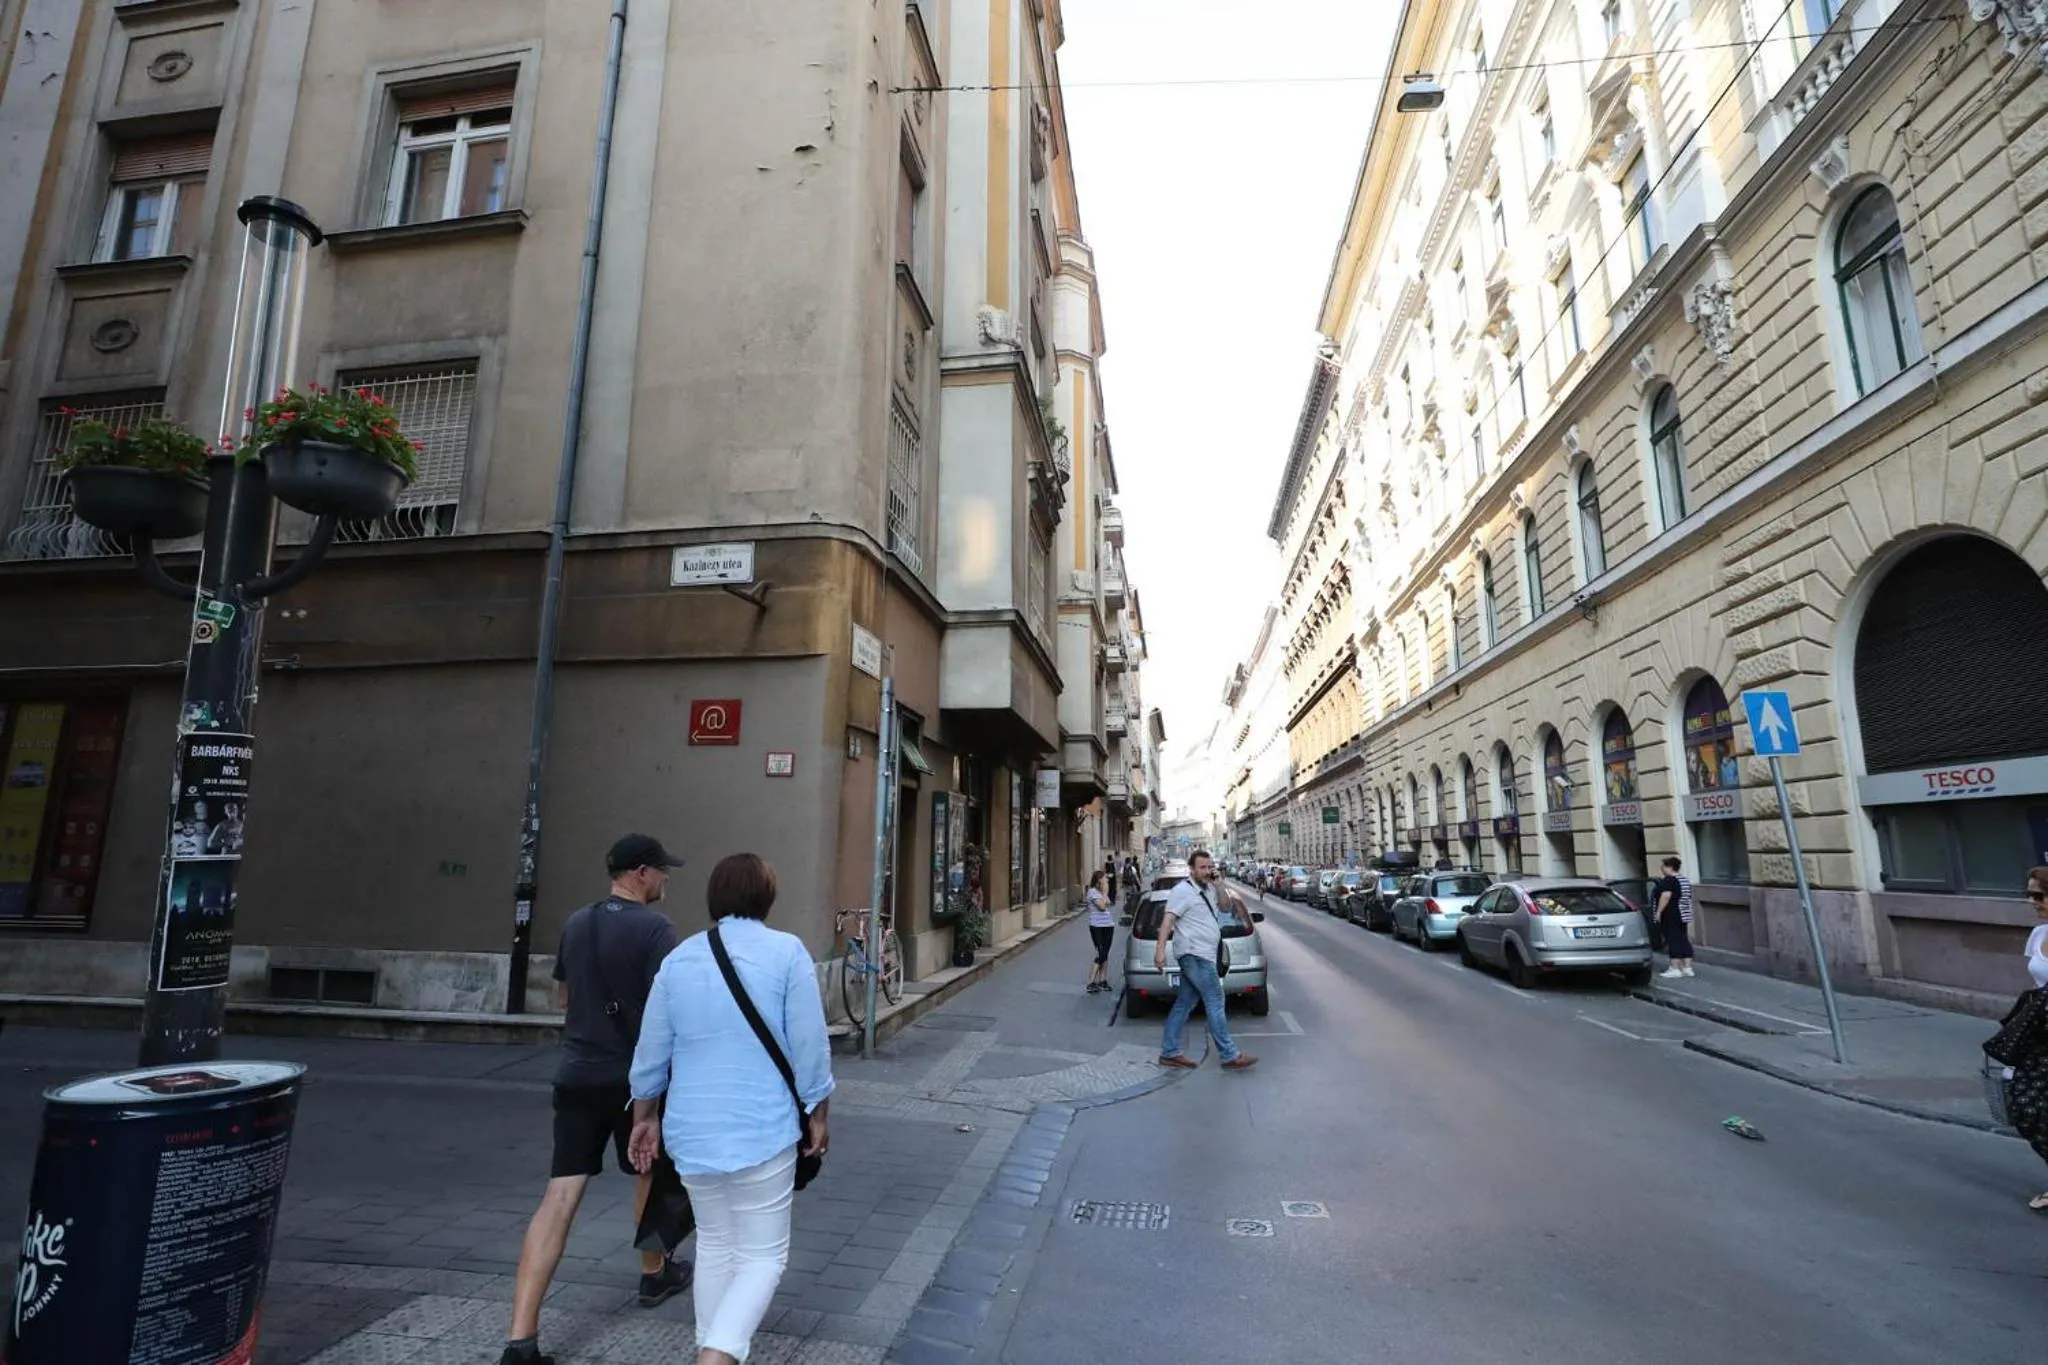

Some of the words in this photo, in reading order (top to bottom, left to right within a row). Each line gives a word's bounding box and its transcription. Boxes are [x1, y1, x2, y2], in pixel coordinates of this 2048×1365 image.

[683, 560, 722, 573] Kazinczy
[722, 558, 743, 569] utca
[221, 765, 240, 776] NKS
[1922, 767, 1994, 788] TESCO
[1694, 795, 1733, 810] TESCO
[1611, 804, 1637, 817] TESCO
[22, 1209, 67, 1266] ake
[22, 1273, 63, 1321] JOHNNY
